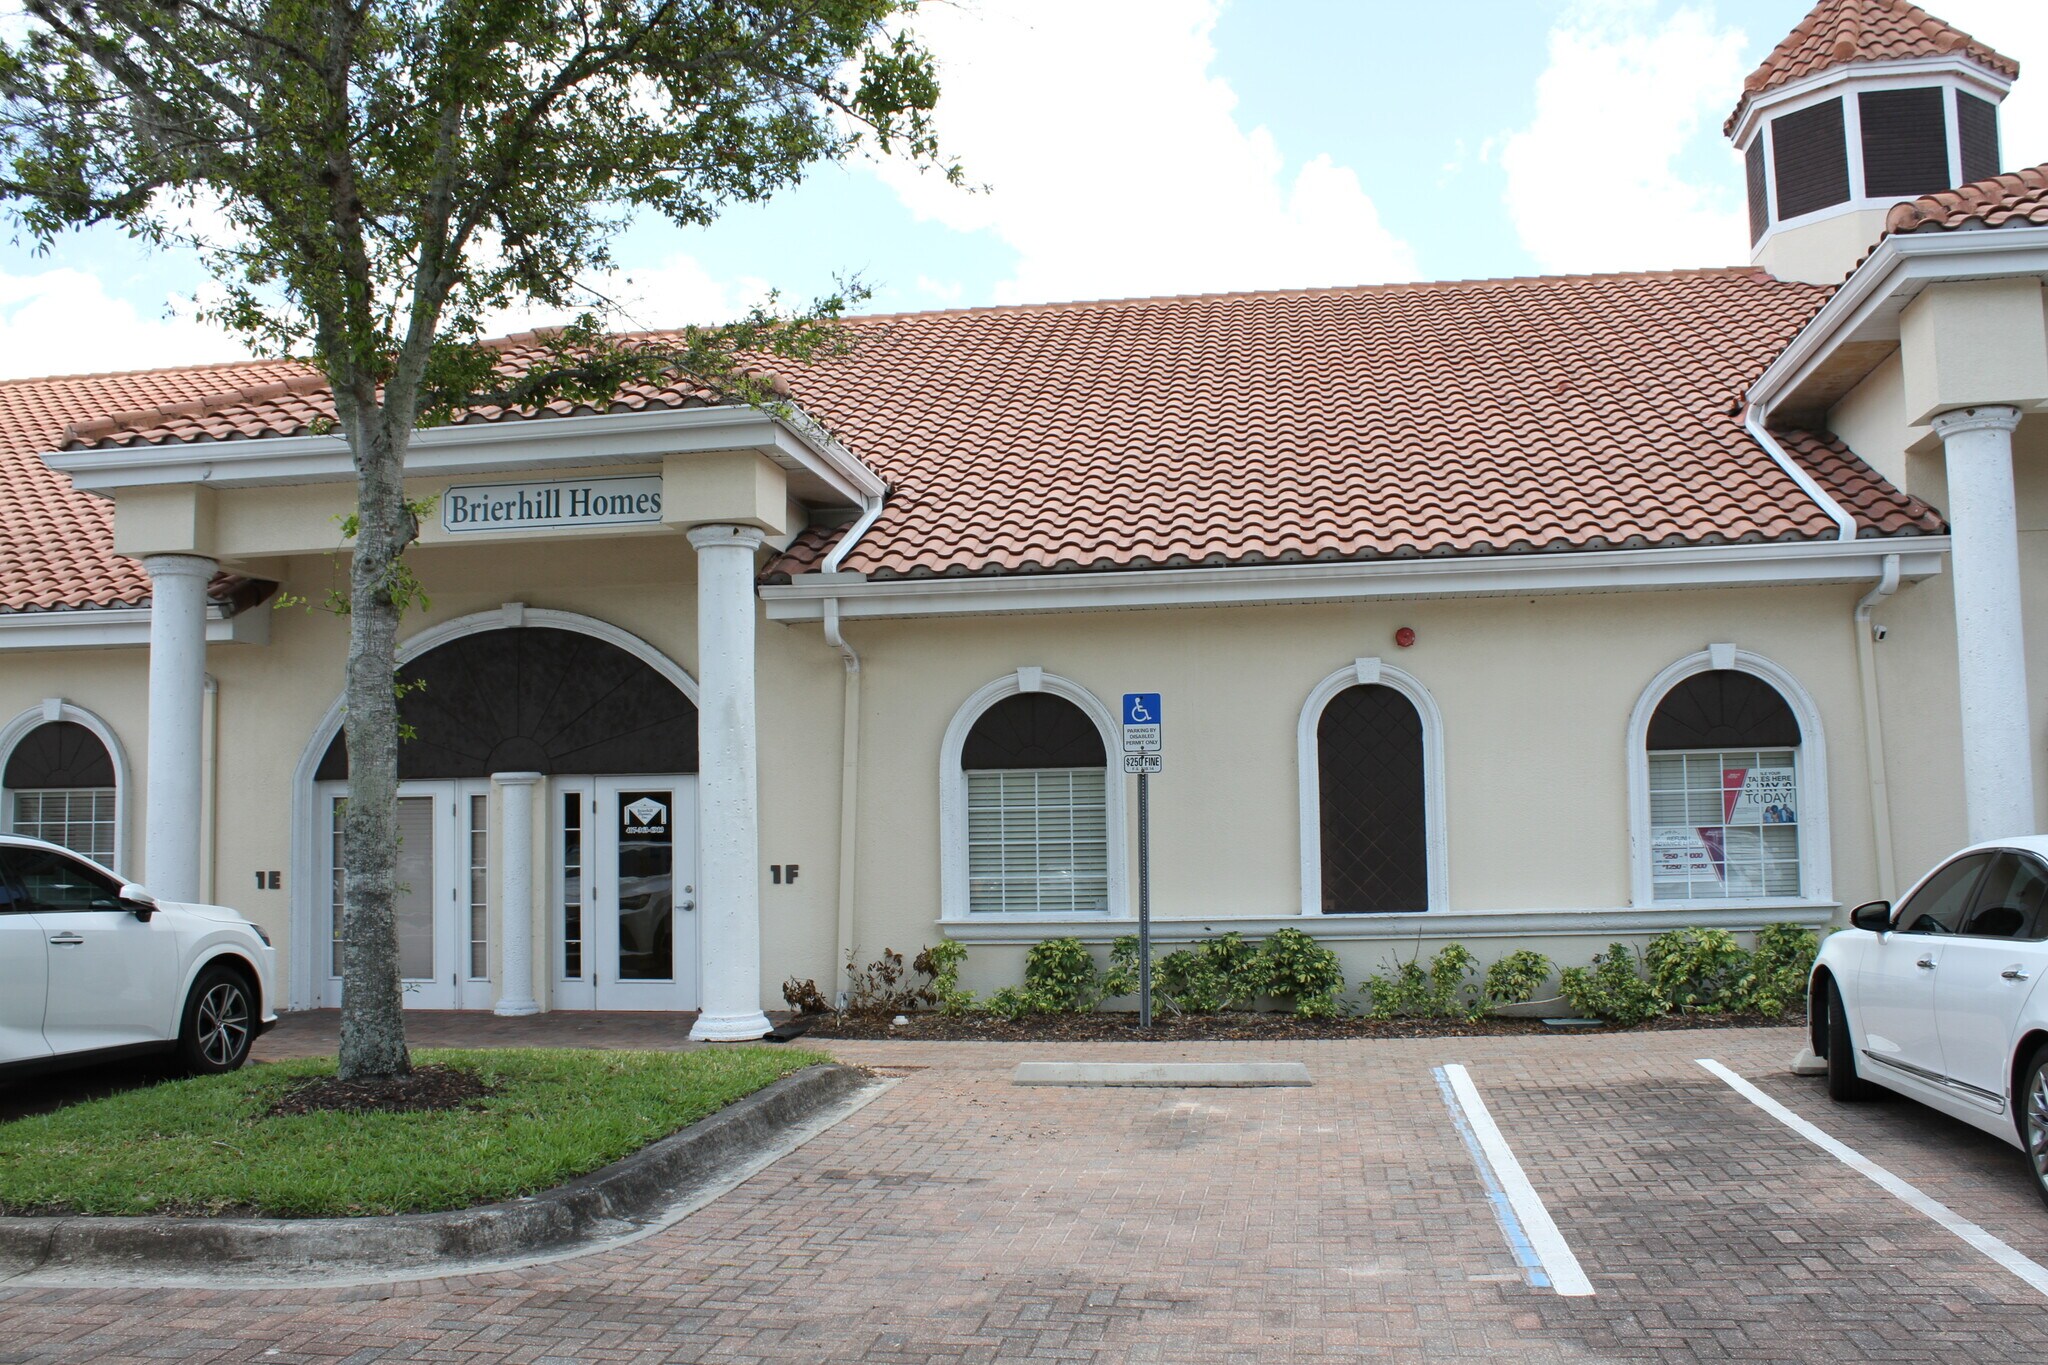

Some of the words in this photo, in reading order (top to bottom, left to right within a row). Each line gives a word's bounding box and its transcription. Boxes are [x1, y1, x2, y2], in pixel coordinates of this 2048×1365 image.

[451, 488, 562, 524] Brierhill
[569, 488, 662, 517] Homes
[1126, 757, 1143, 767] $250
[1144, 757, 1159, 766] FINE
[1745, 792, 1793, 804] TODAY!
[255, 871, 281, 889] 1E
[770, 864, 799, 884] 1F
